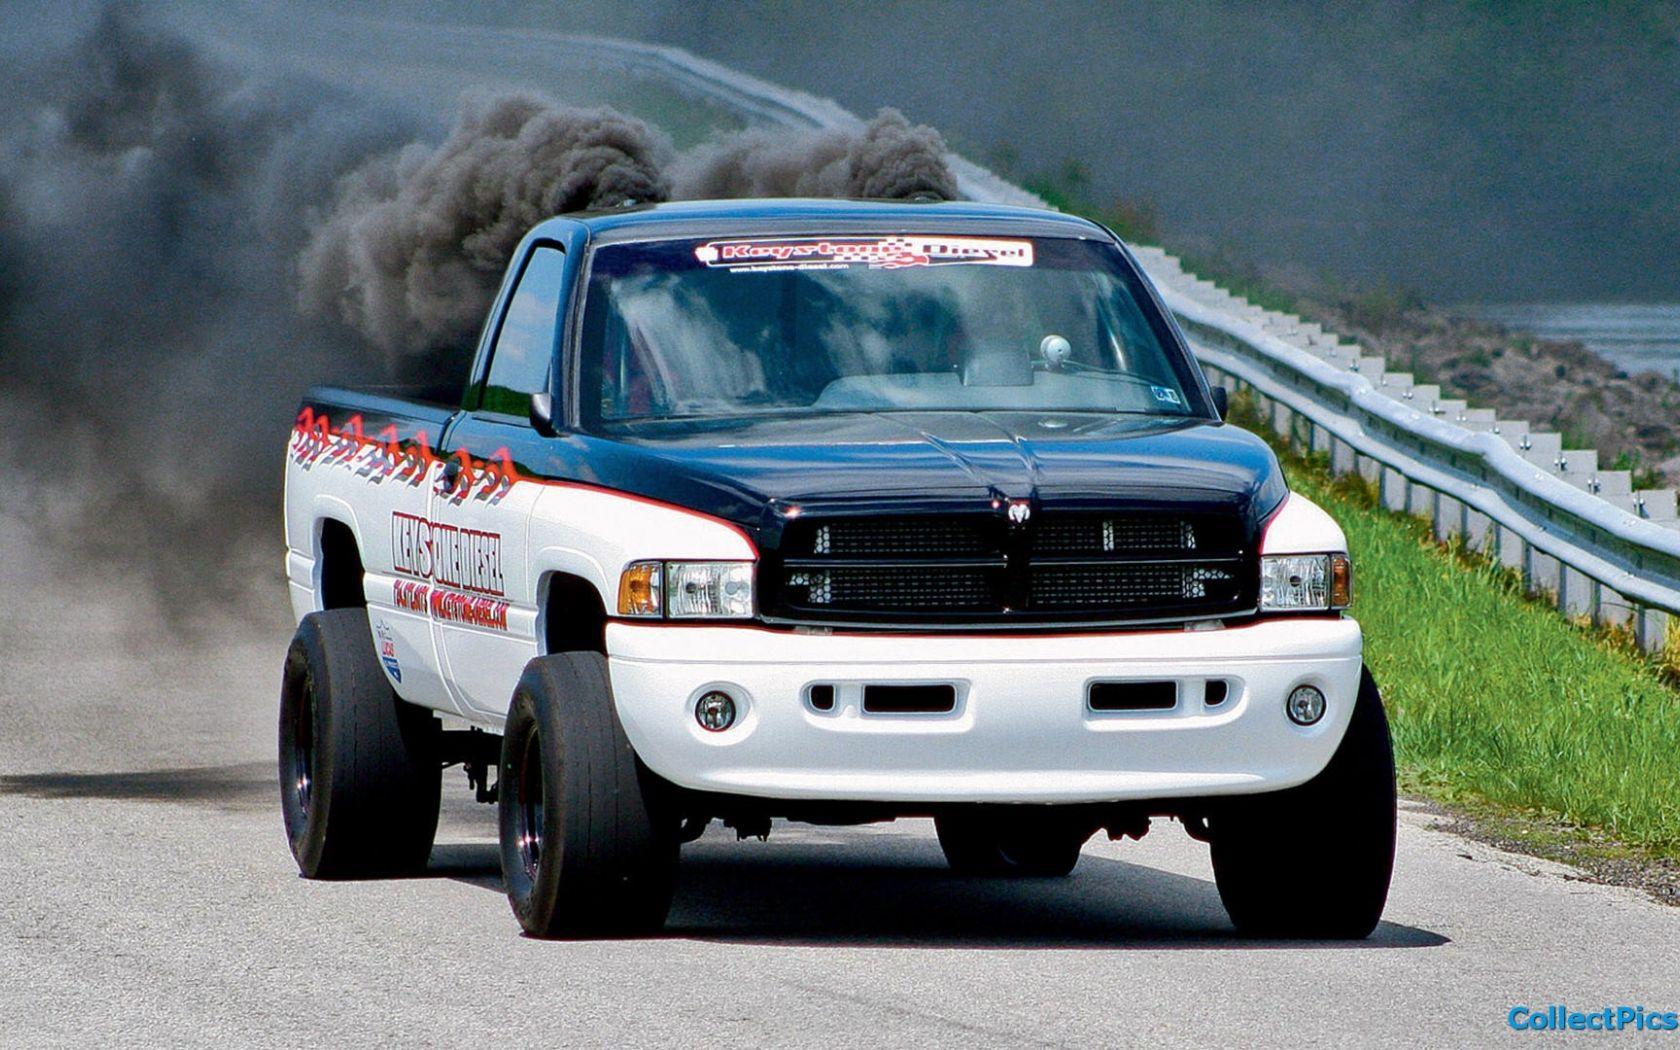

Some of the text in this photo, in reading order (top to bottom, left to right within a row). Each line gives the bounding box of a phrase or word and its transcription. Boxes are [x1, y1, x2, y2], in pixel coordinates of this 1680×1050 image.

[922, 243, 1026, 259] Diesel
[391, 511, 461, 588] KEYSONE
[459, 528, 505, 597] DIESEL
